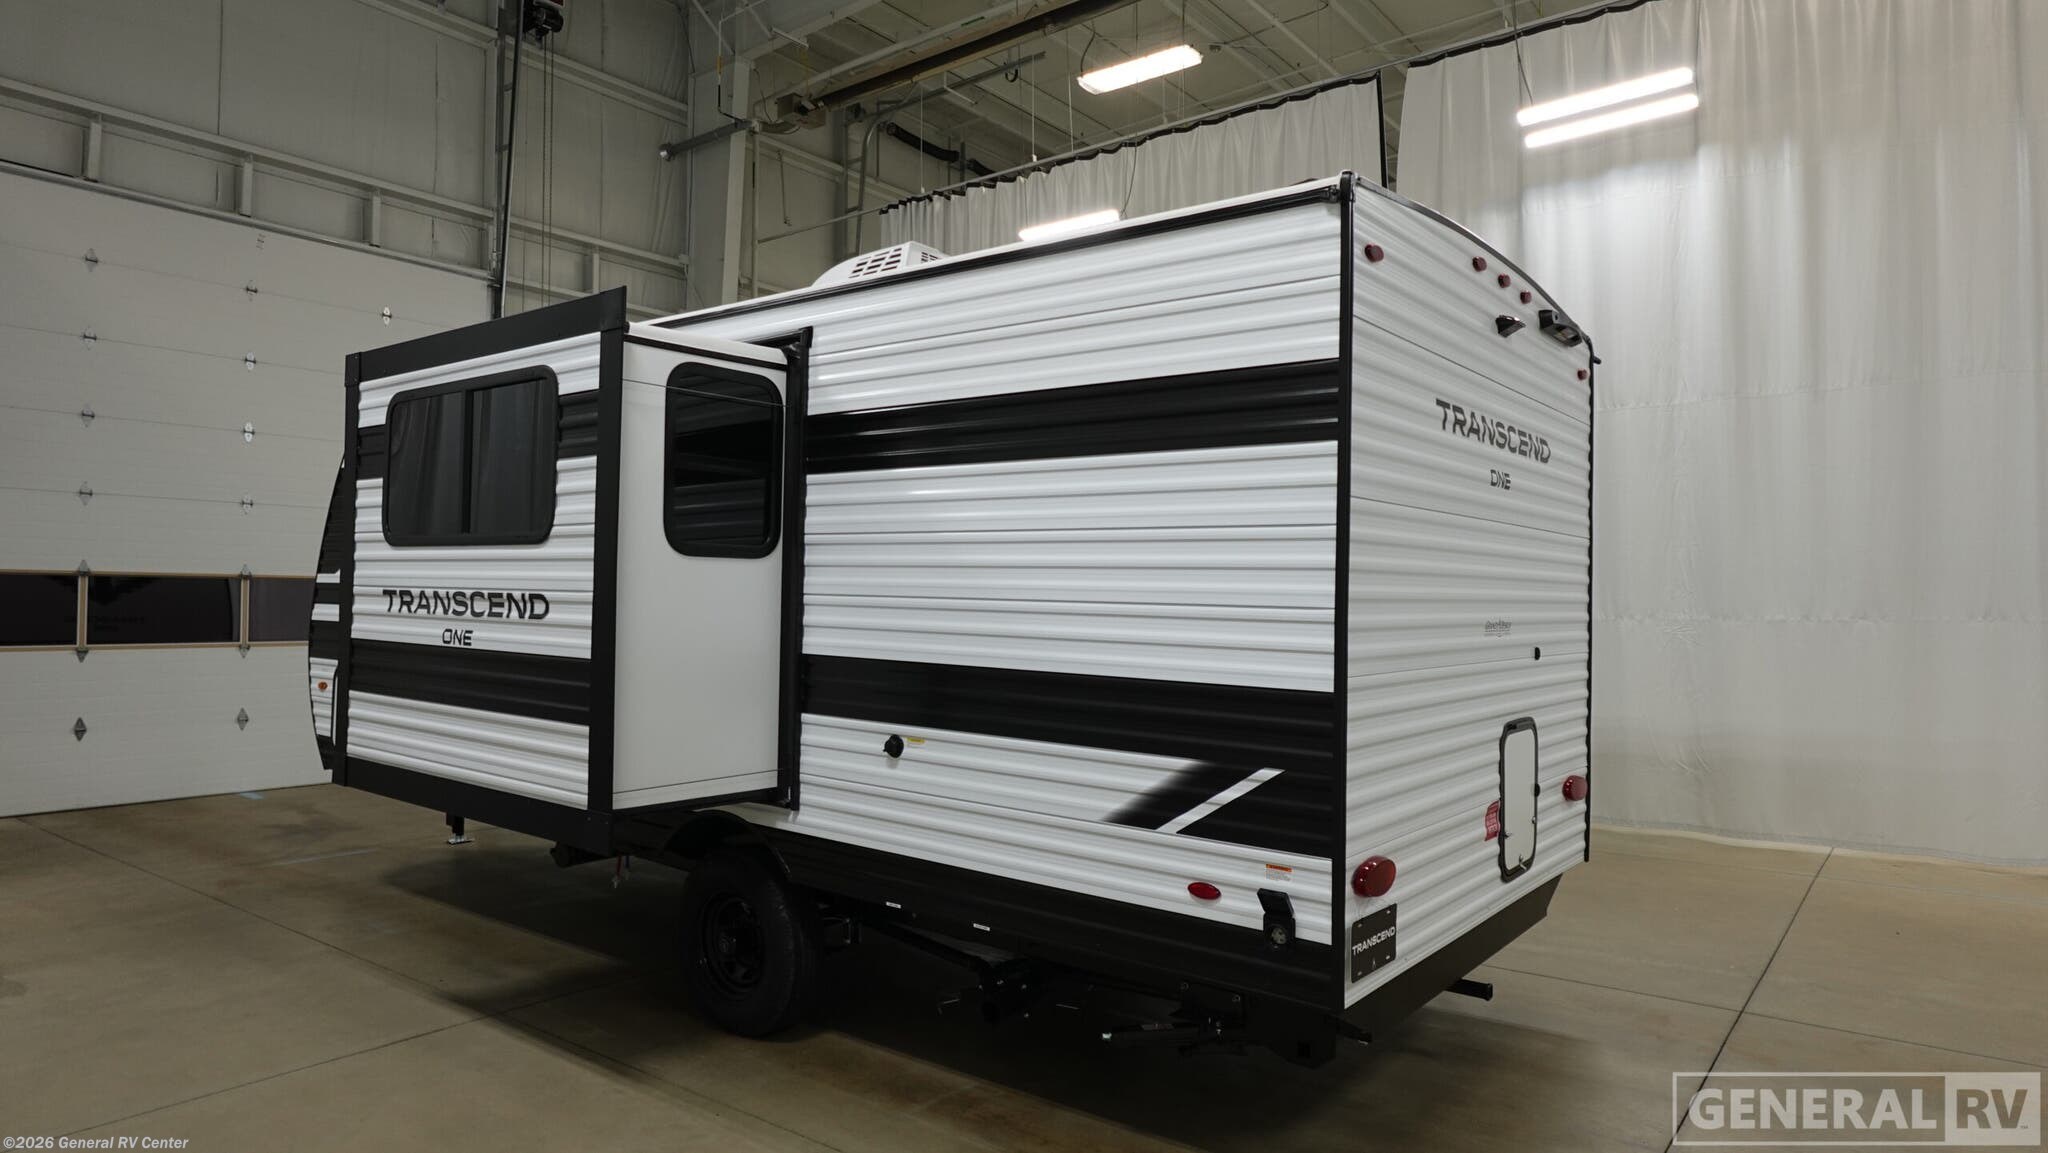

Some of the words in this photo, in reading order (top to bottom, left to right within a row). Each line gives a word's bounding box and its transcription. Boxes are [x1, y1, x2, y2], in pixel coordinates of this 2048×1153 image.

[1435, 397, 1551, 464] TRANSCEND
[382, 588, 550, 620] TRANSCEND
[442, 628, 474, 647] ONE
[1352, 926, 1396, 956] TRANSCEND
